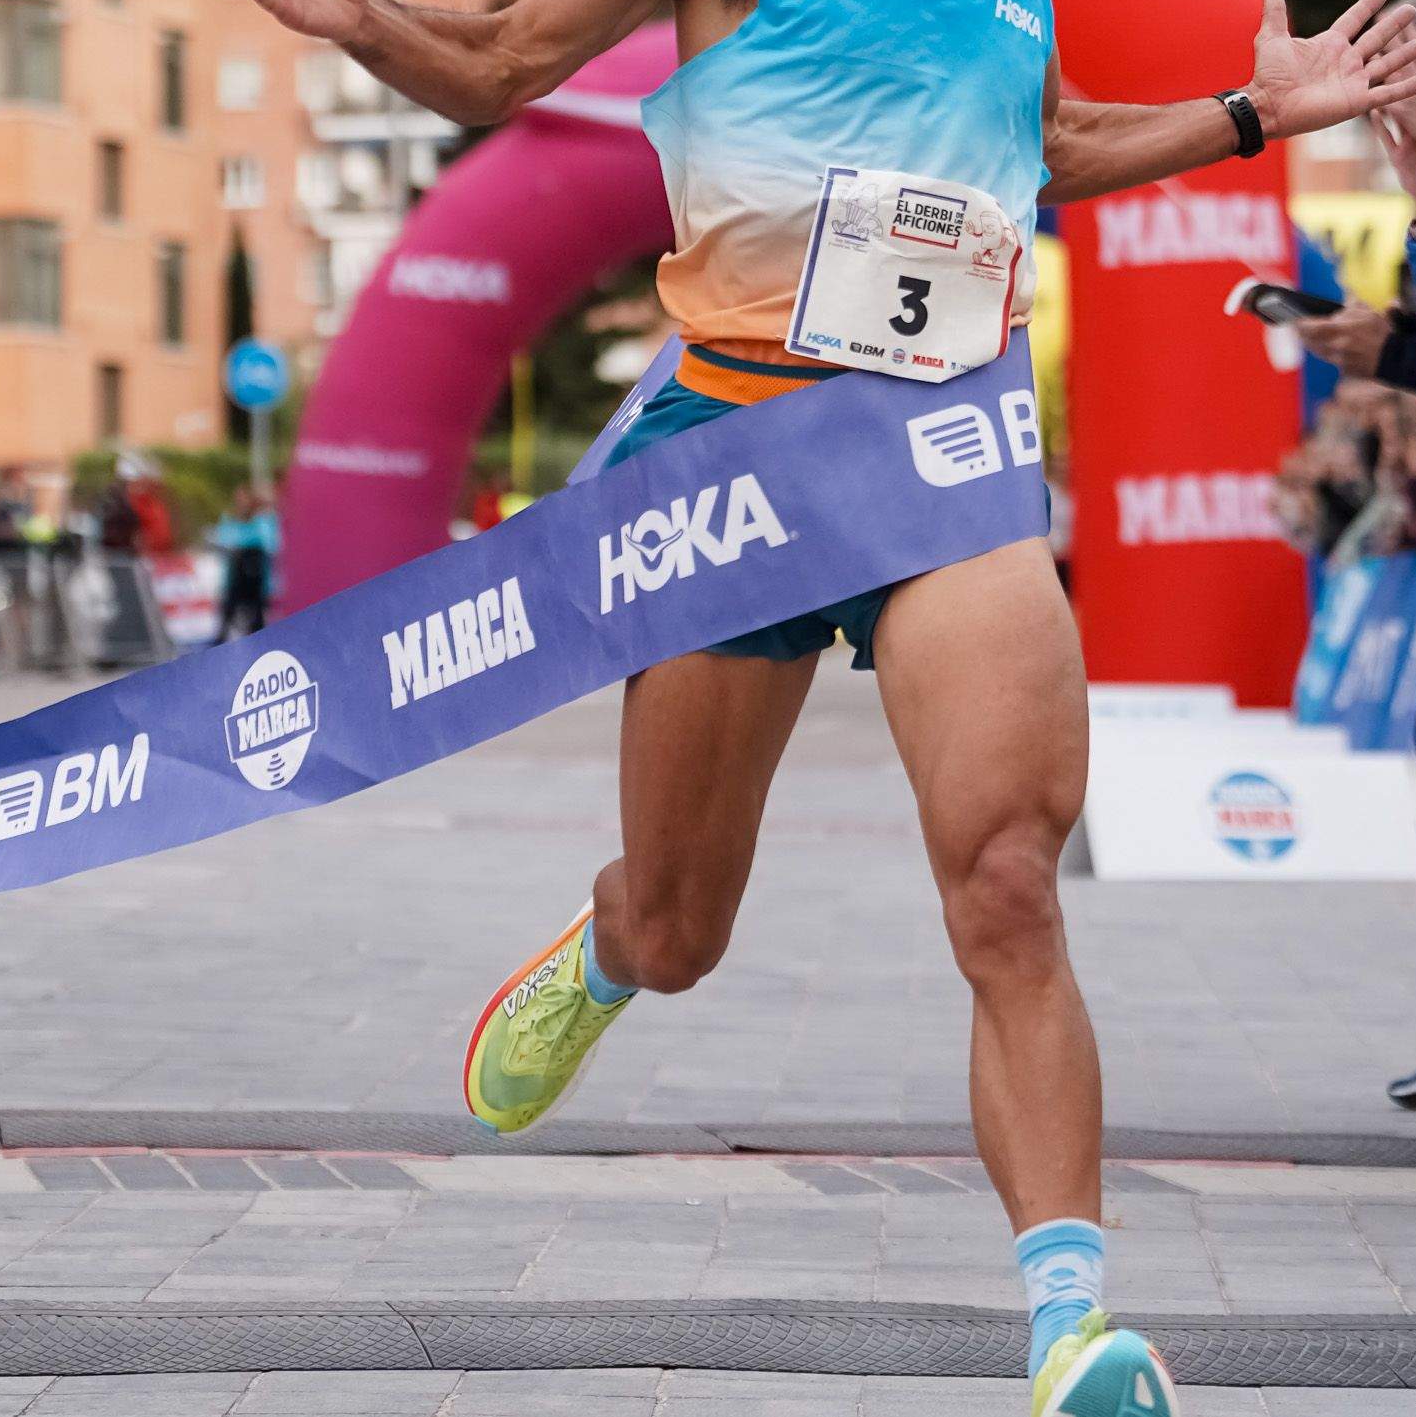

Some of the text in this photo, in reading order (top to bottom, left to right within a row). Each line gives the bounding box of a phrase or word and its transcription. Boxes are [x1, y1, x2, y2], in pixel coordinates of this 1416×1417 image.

[893, 213, 962, 238] AFICIONES
[895, 199, 953, 223] EL DERBI
[1095, 191, 1288, 268] MARCA
[888, 274, 932, 337] 3
[806, 331, 843, 350] HOKA
[862, 344, 885, 359] BM
[912, 353, 945, 369] MARCA
[998, 388, 1042, 468] B
[598, 471, 790, 616] HOKA
[383, 576, 536, 711] MARCA
[241, 664, 299, 708] RADIO
[236, 693, 311, 751] MARCA
[44, 731, 150, 828] BM
